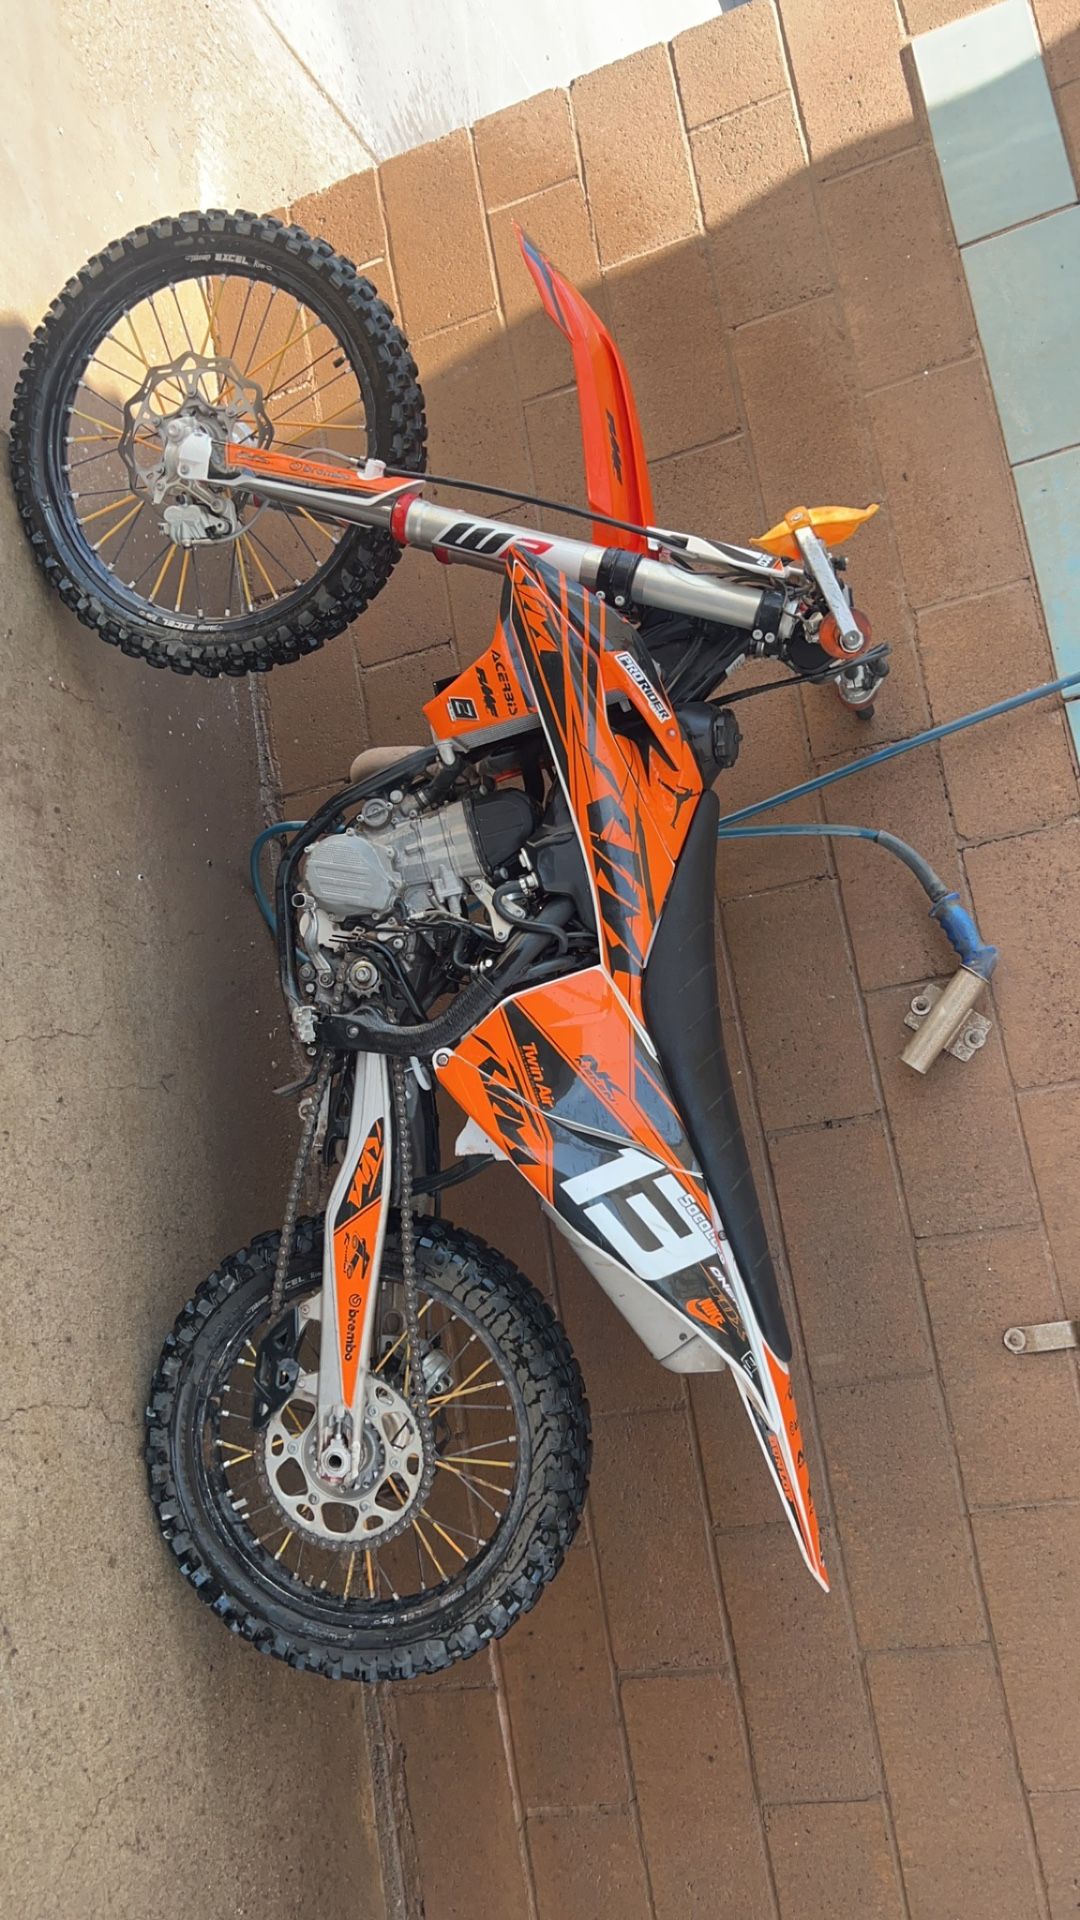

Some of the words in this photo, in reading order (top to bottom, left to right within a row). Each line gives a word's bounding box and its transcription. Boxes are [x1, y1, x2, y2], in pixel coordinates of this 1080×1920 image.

[492, 650, 517, 716] ACERBIS
[522, 1042, 547, 1081] Twin
[536, 1084, 555, 1108] Air
[559, 1148, 719, 1281] 13
[344, 1309, 360, 1362] brembo
[697, 1298, 726, 1327] NIKE
[768, 1435, 794, 1503] DUNLOP
